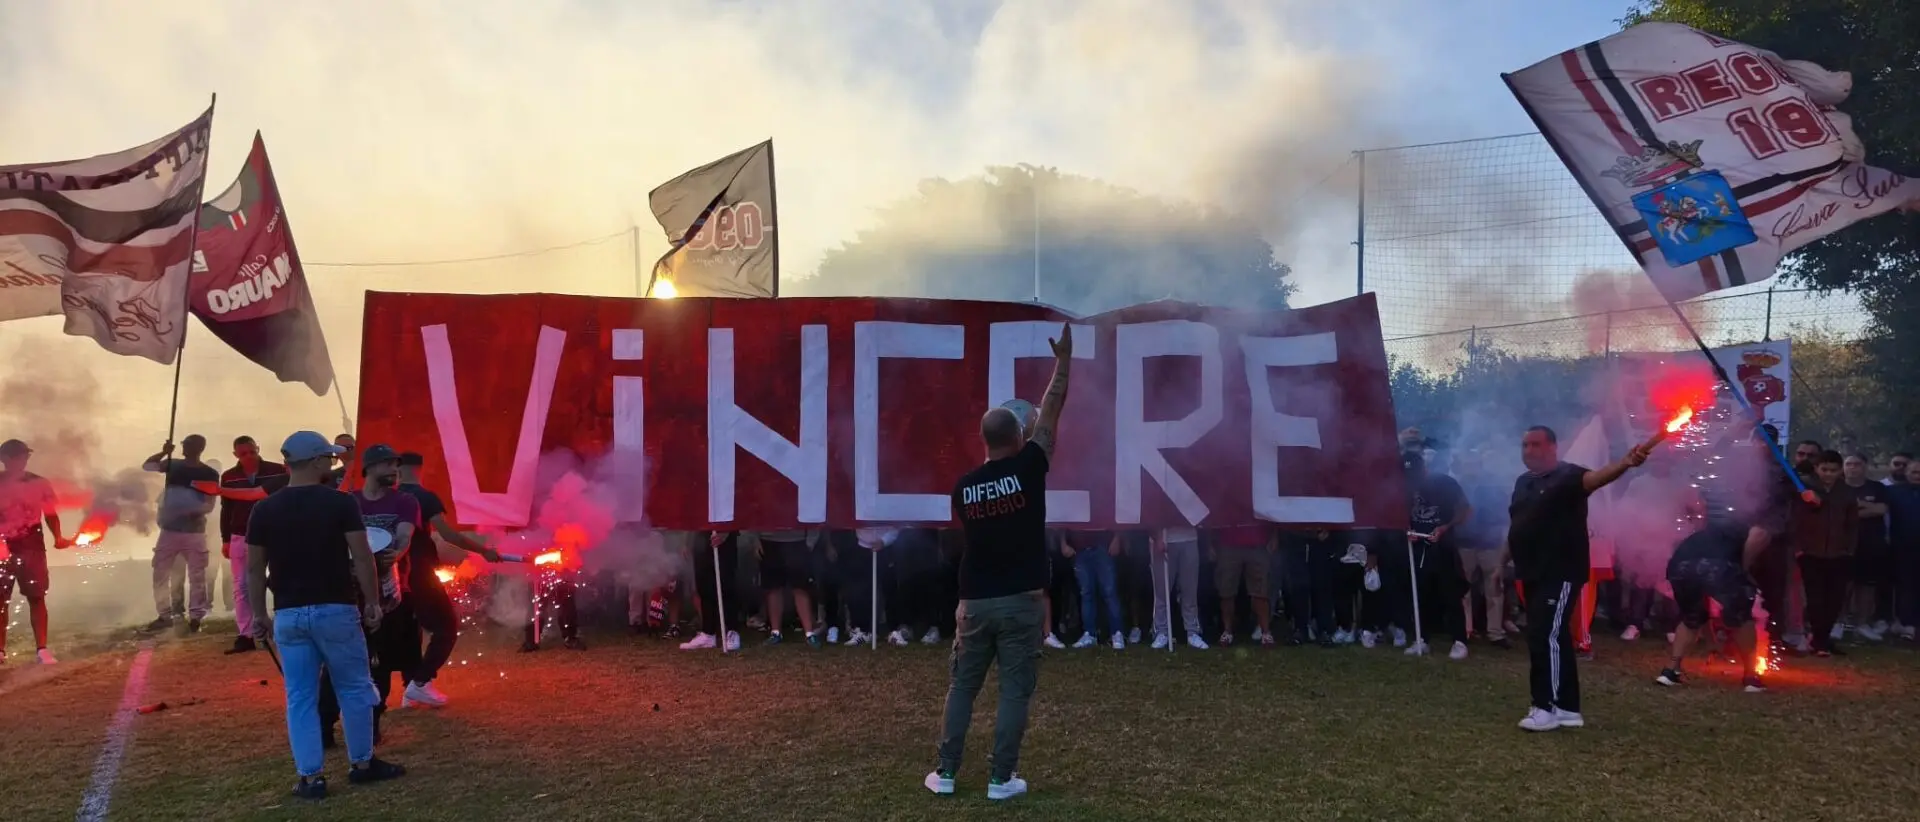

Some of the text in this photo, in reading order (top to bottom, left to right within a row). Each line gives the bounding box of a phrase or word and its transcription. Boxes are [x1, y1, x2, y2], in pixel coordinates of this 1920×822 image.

[1631, 51, 1799, 123] REG
[1726, 95, 1842, 160] 19
[963, 474, 1022, 505] DIFENDI
[965, 494, 1026, 520] REGGIO
